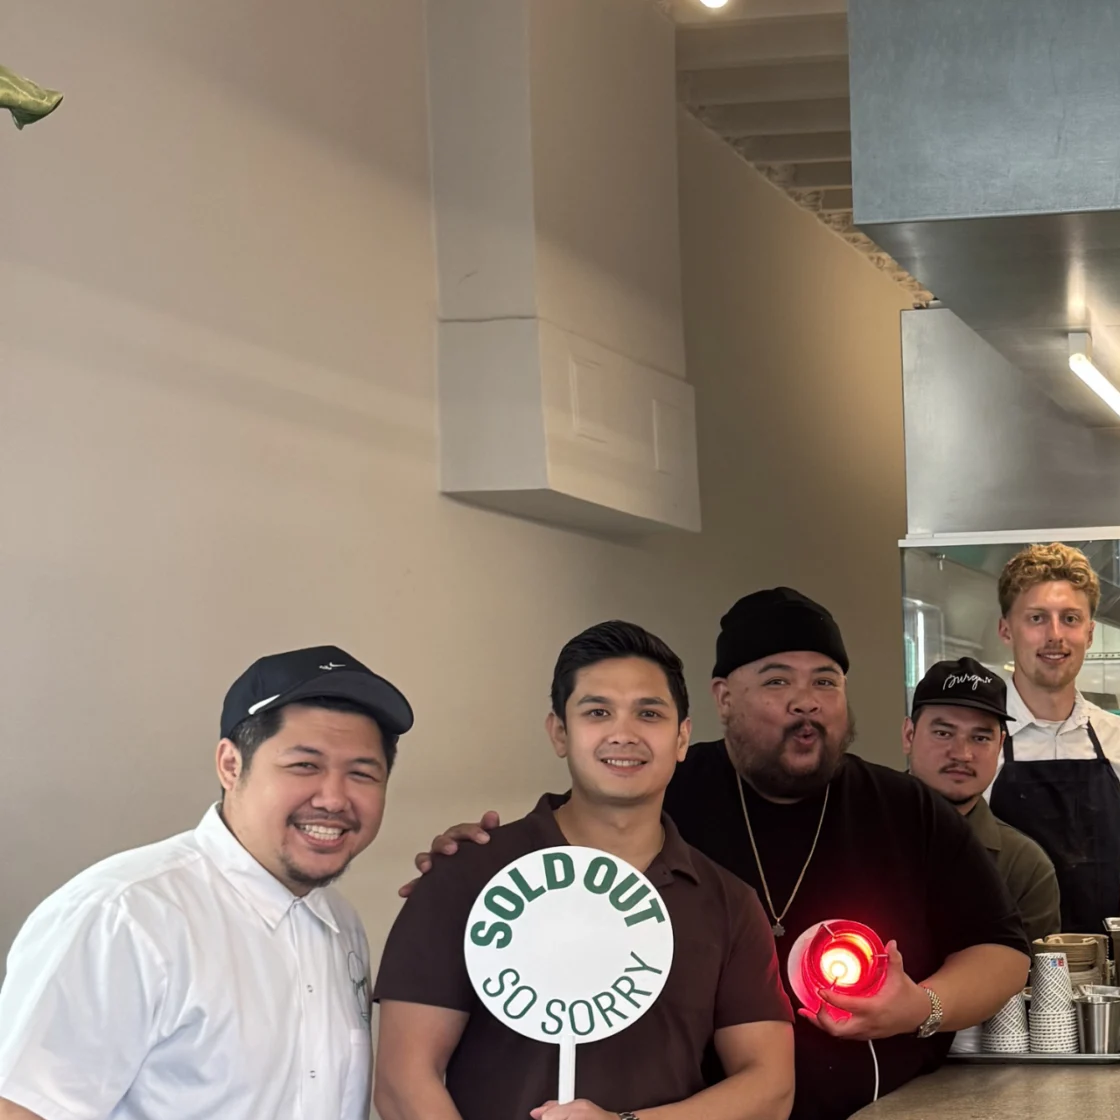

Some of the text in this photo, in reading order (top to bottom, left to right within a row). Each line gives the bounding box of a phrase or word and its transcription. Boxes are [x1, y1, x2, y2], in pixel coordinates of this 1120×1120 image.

[470, 852, 666, 949] SOLD OUT
[482, 951, 663, 1036] SO SORRY
